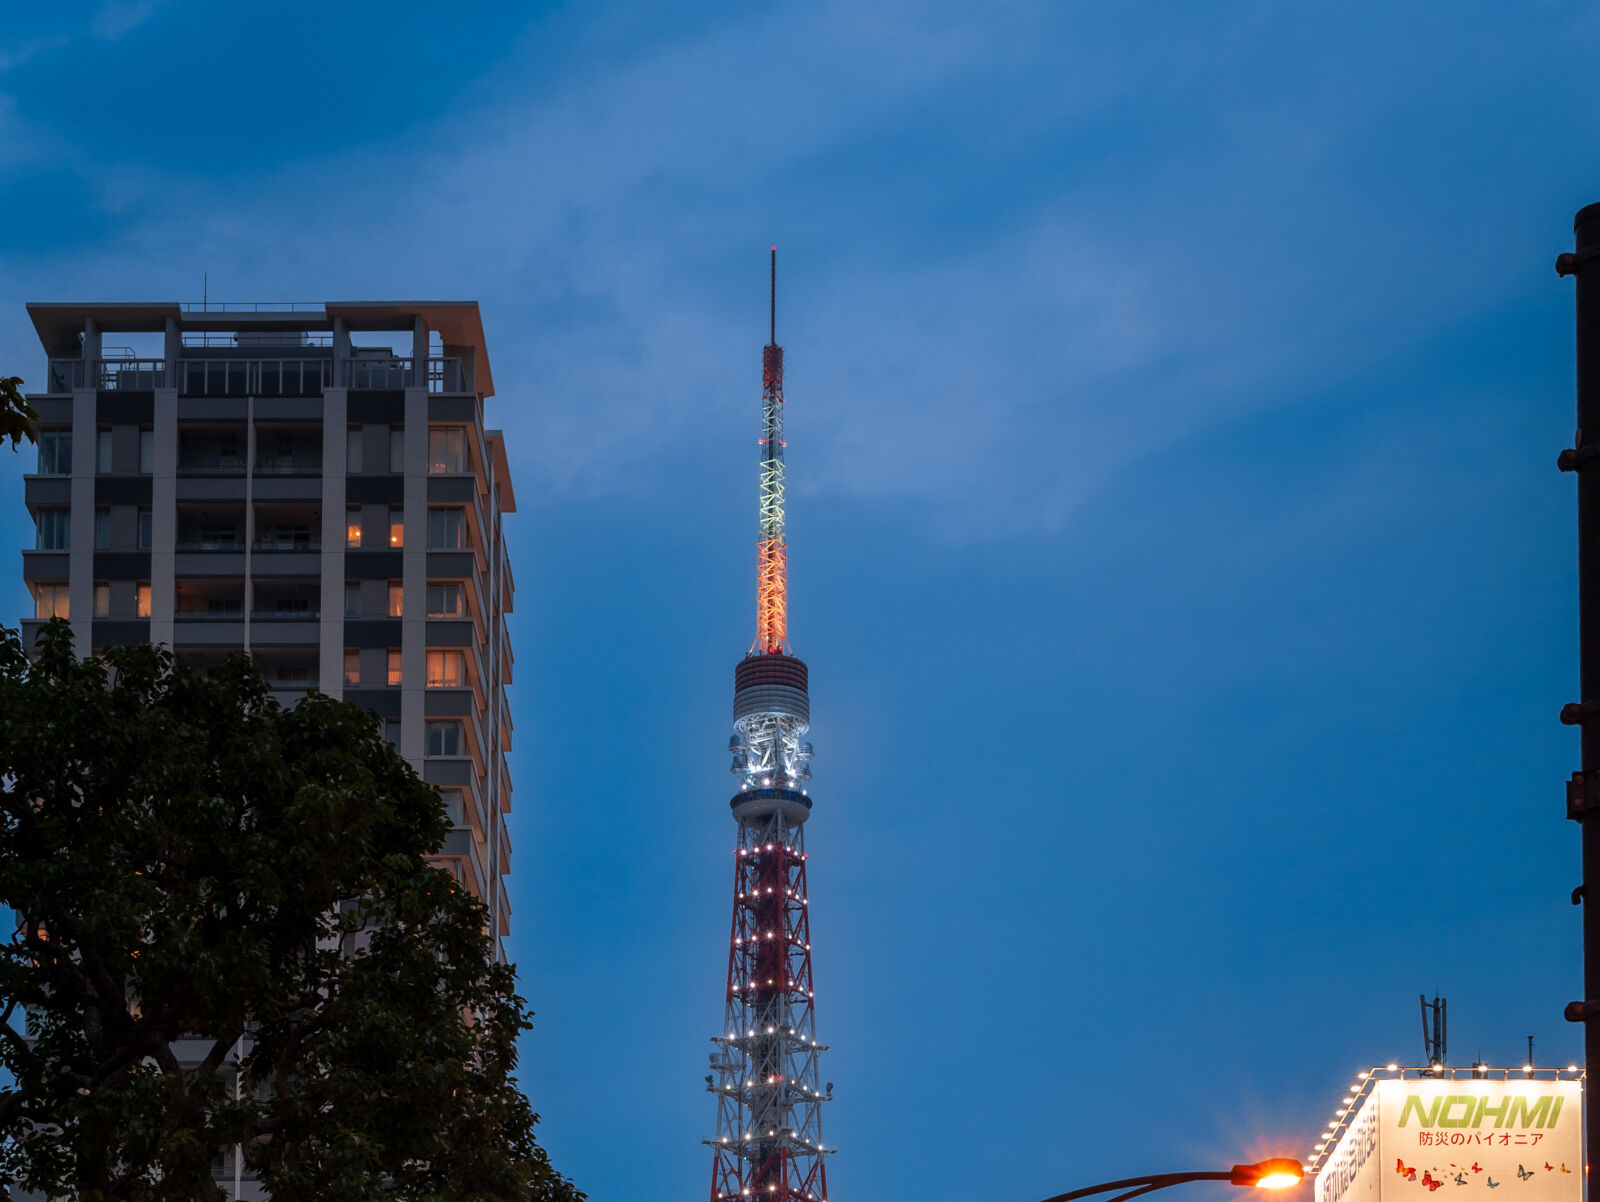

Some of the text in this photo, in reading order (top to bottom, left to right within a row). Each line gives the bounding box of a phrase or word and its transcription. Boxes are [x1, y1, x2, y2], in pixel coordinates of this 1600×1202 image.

[1398, 1095, 1564, 1129] NOHMI
[1419, 1131, 1544, 1146] 防災のパイオニア
